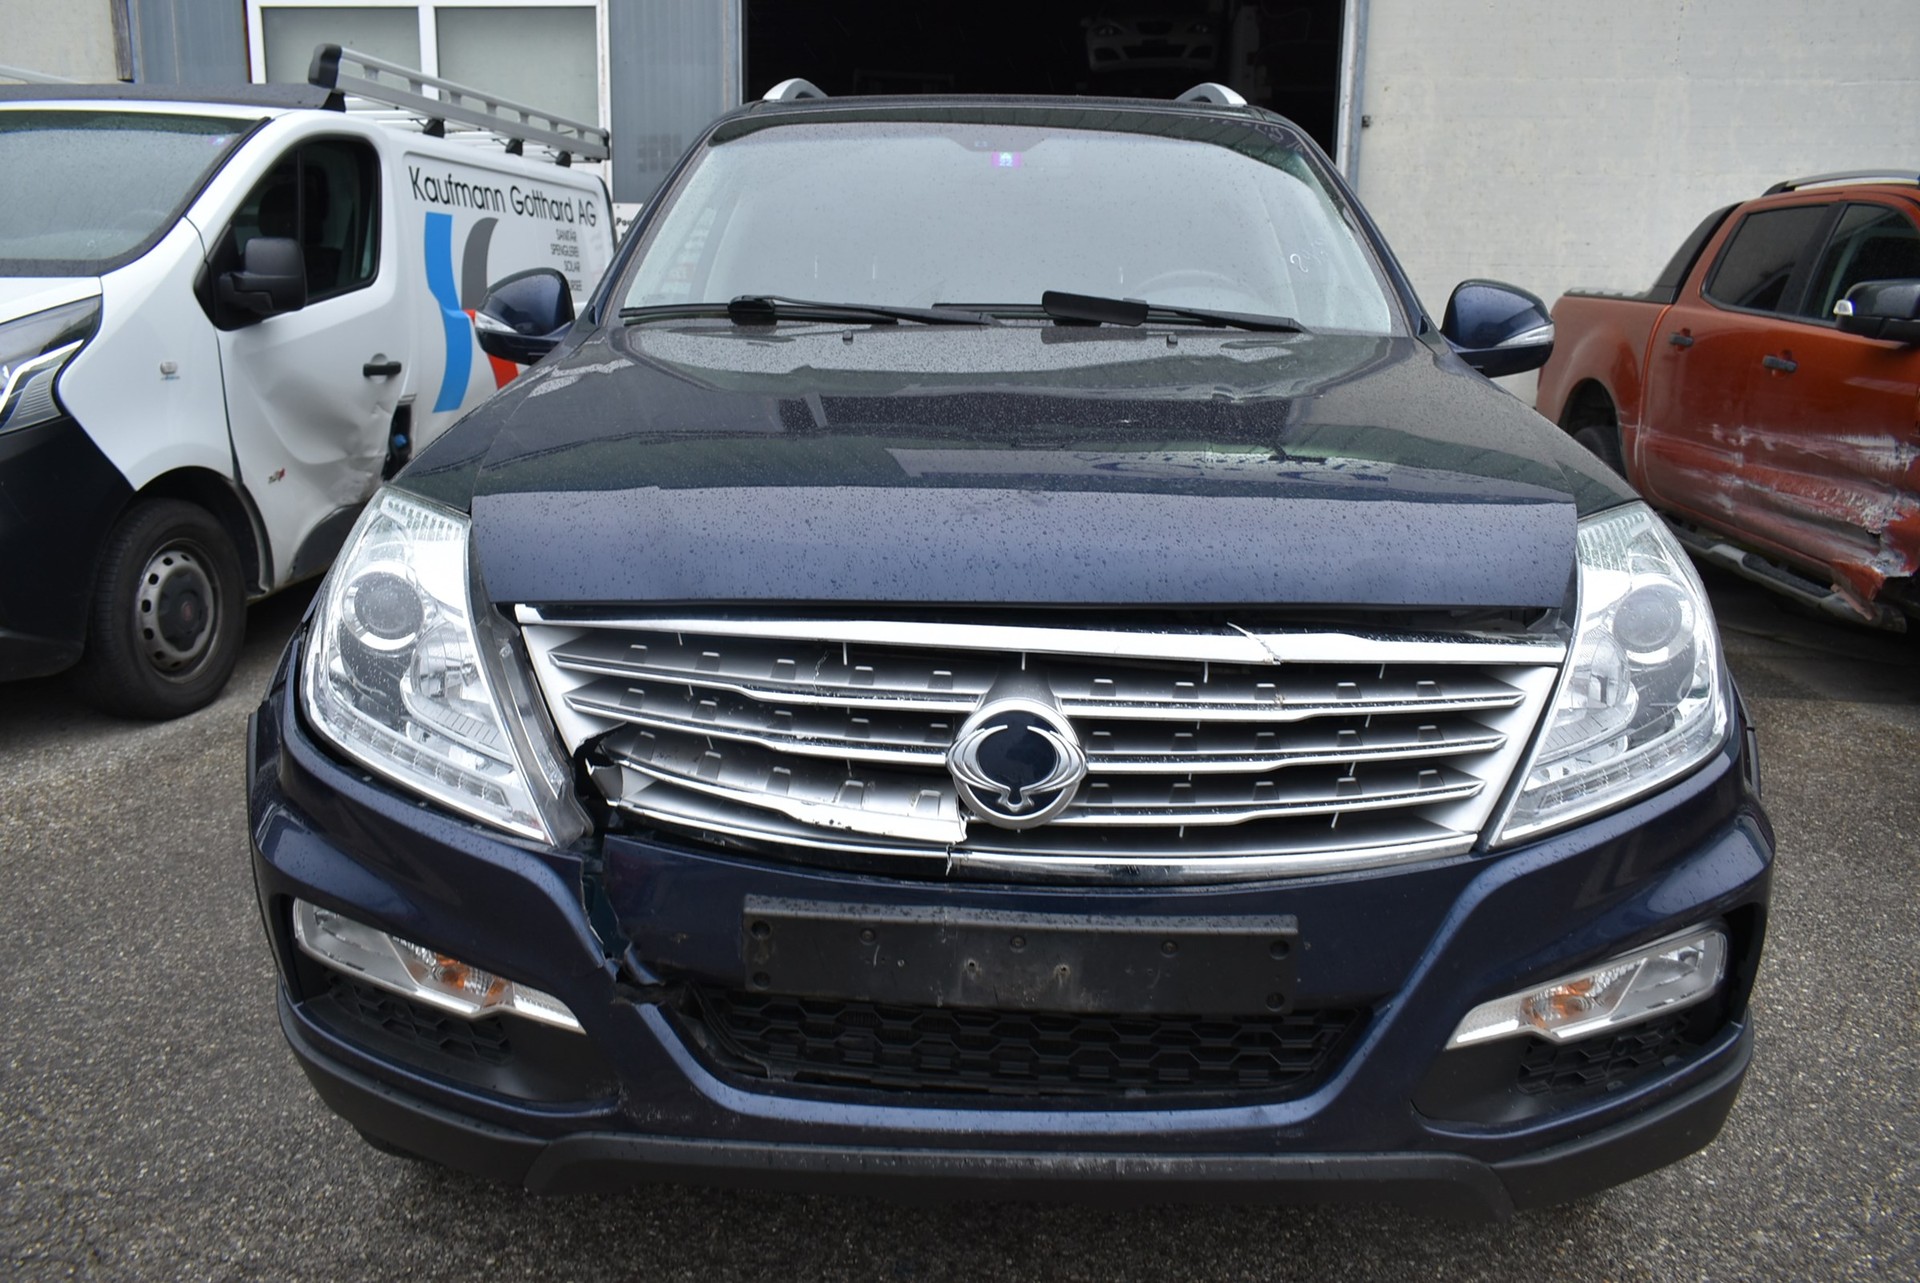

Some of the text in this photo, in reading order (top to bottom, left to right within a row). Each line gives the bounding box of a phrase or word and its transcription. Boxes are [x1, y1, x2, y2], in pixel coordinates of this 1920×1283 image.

[408, 166, 597, 227] Kaufmann Gotthard AG
[564, 260, 581, 272] SOLAR
